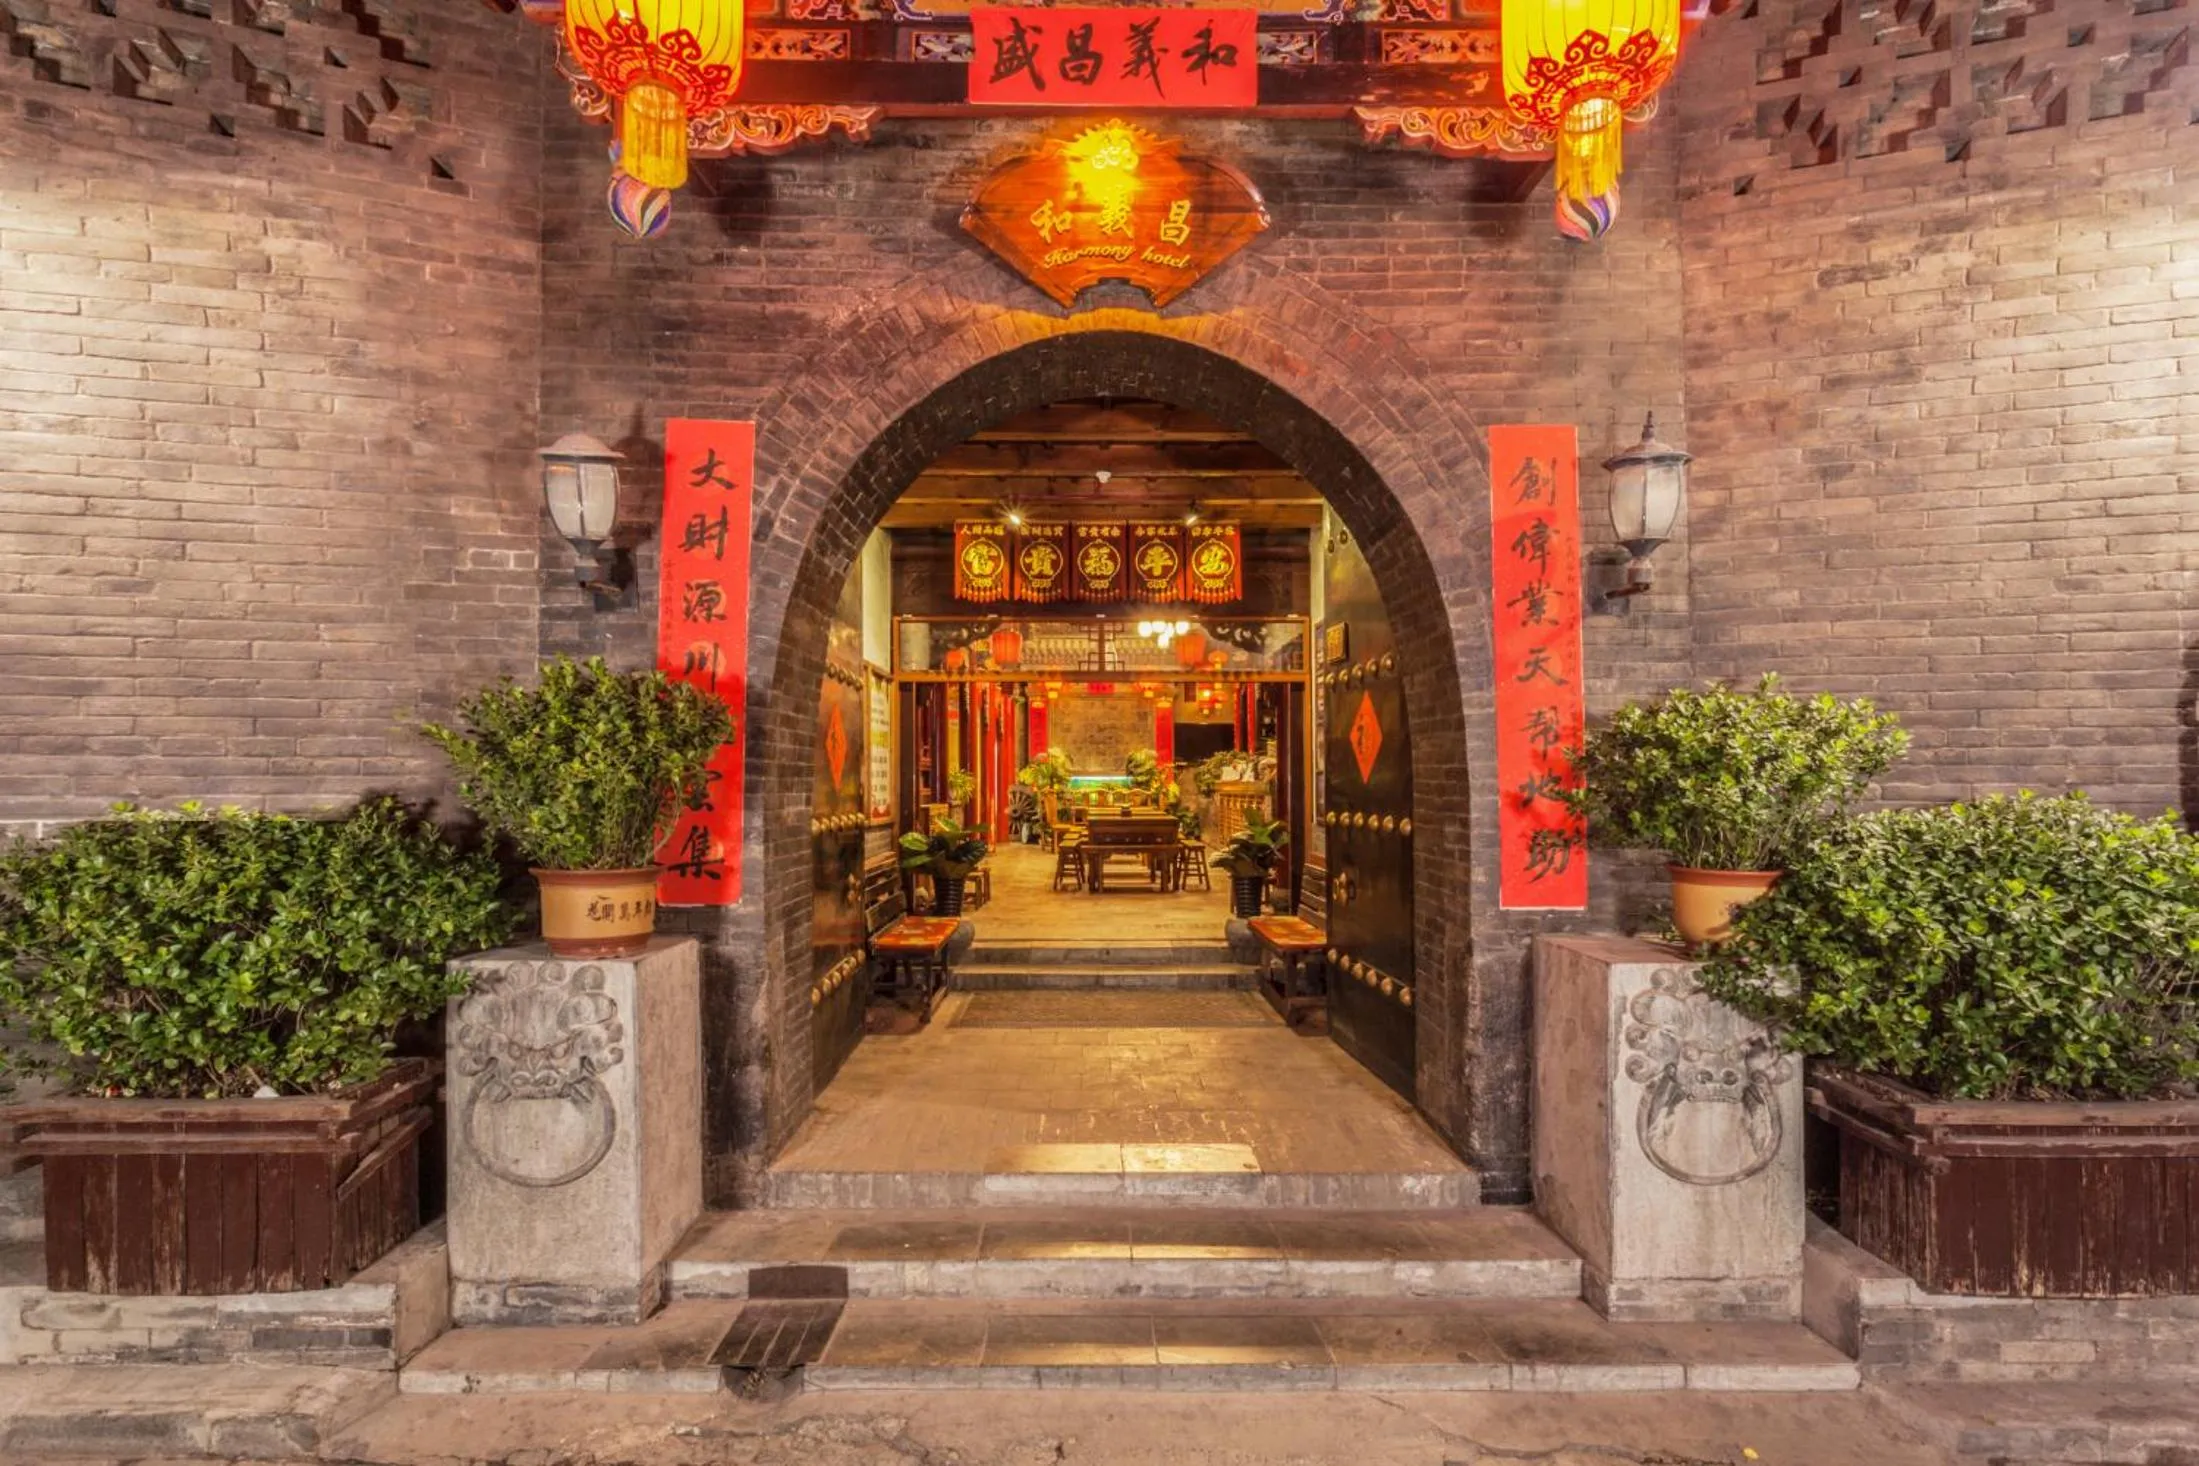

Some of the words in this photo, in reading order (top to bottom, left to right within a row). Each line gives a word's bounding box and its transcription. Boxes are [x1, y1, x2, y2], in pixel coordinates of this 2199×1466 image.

[1043, 245, 1136, 268] Harmony
[1141, 246, 1191, 268] hotel
[1140, 546, 1173, 576] 平
